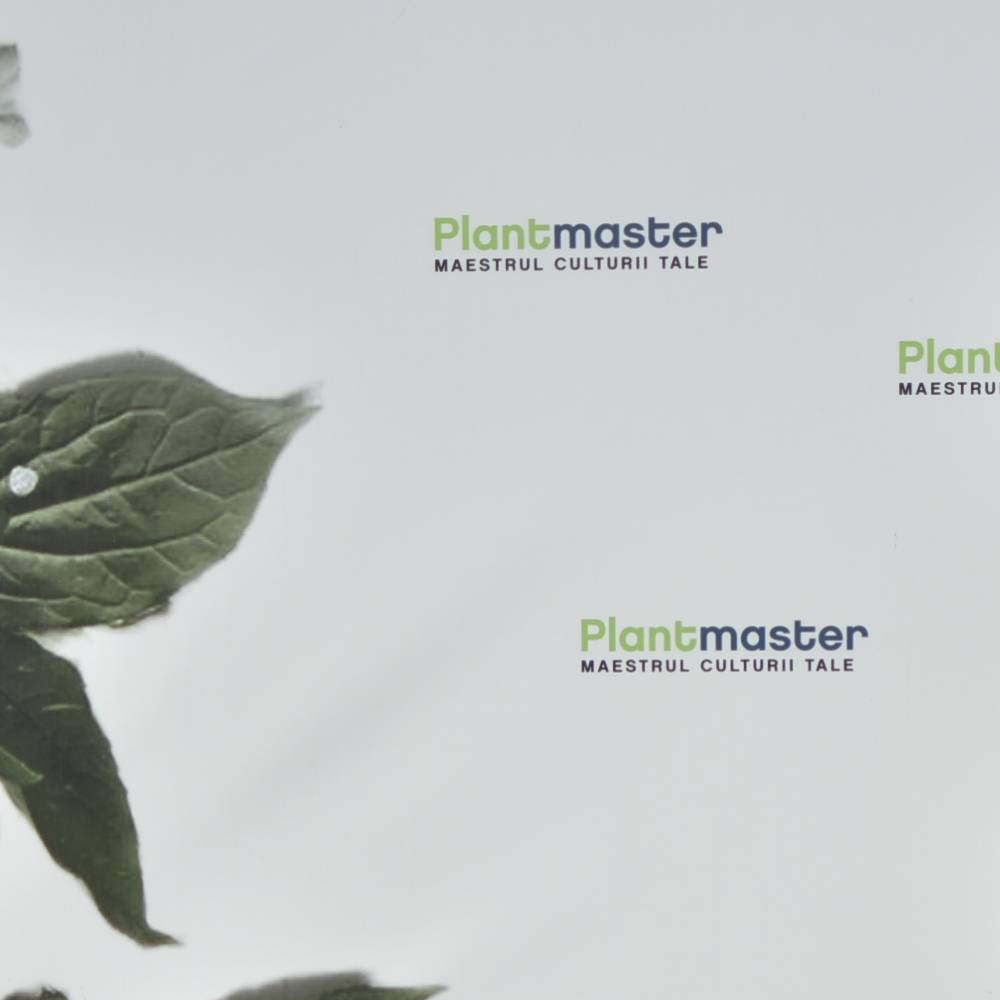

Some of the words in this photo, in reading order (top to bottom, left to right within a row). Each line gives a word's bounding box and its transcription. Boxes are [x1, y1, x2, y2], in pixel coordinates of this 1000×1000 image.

[435, 215, 723, 251] Plantmaster
[435, 258, 543, 272] MAESTRUL
[554, 257, 647, 270] CULTURII
[659, 256, 708, 269] TALE
[581, 617, 868, 652] Plantmaster
[581, 659, 689, 672] MAESTRUL
[701, 659, 793, 672] CULTURII
[805, 659, 853, 672] TALE
